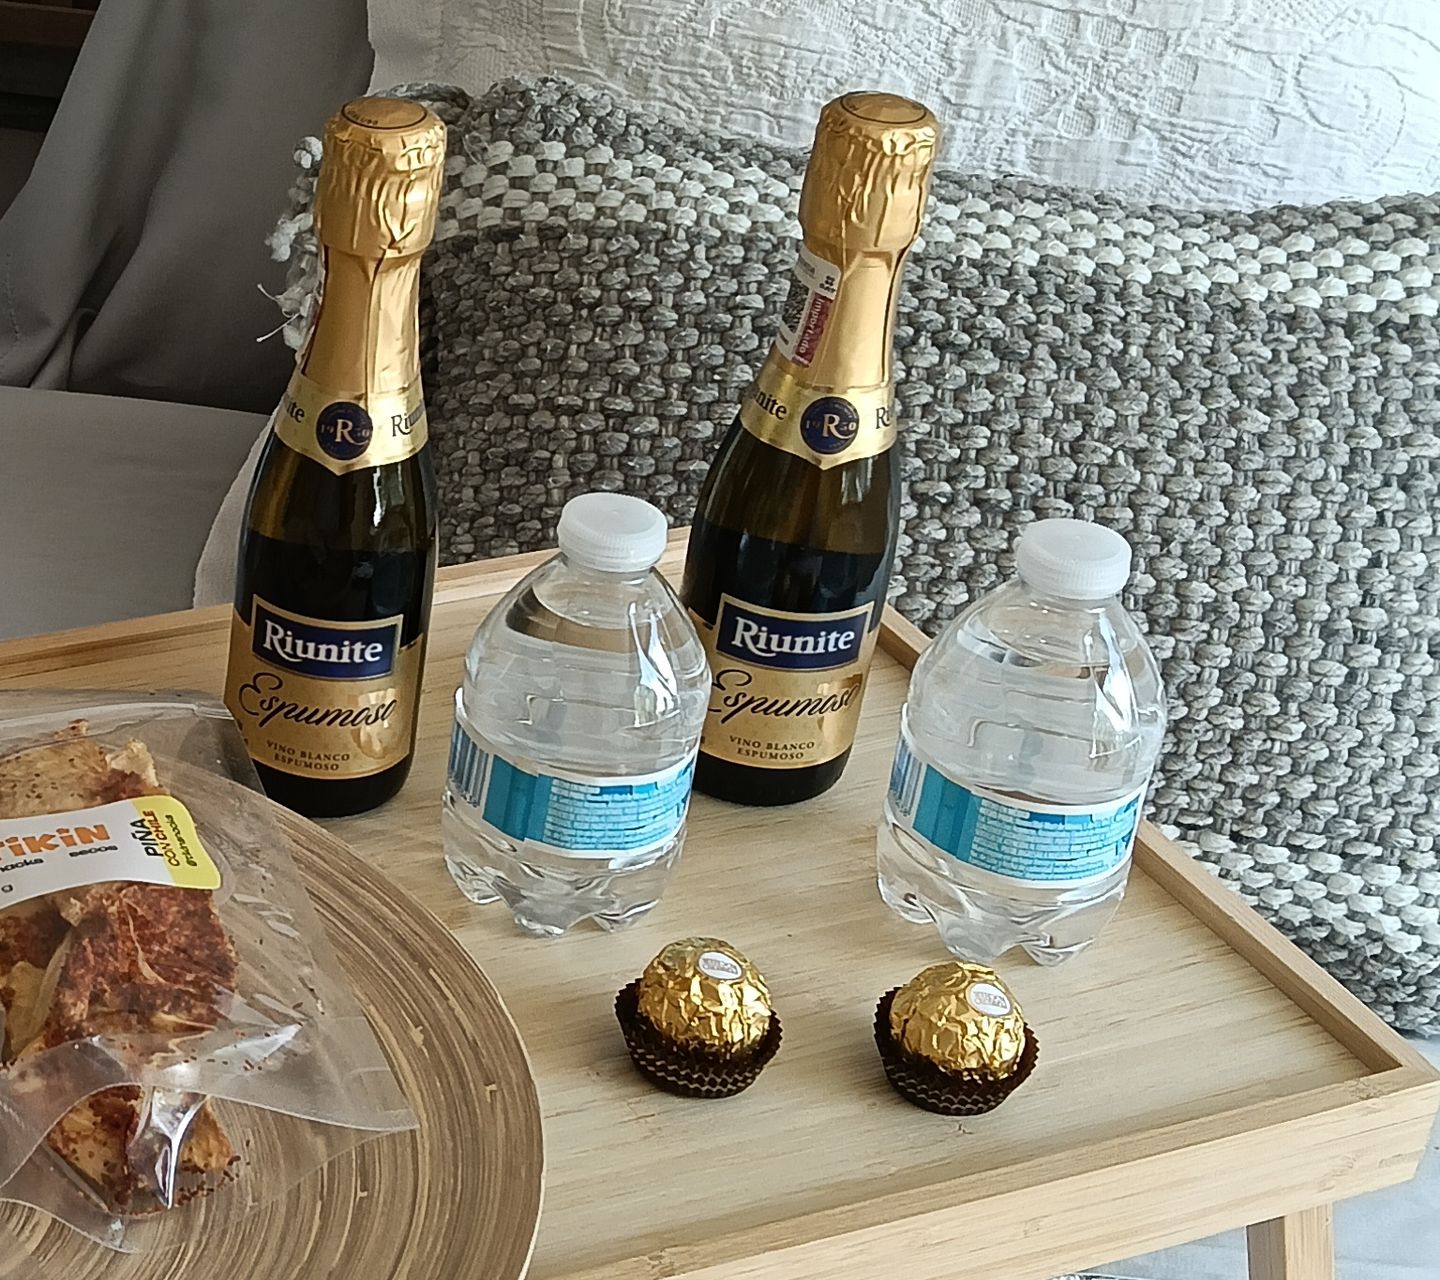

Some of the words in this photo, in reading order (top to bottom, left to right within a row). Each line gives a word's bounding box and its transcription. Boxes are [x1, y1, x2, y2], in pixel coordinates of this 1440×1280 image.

[335, 419, 368, 445] R
[822, 414, 855, 439] R
[262, 619, 383, 663] Riunite
[731, 617, 855, 657] Riunite
[239, 672, 397, 728] Espumoso
[266, 740, 296, 755] VINO
[300, 751, 350, 761] BLANCO
[729, 735, 762, 749] VINO
[766, 741, 815, 751] BLANCO
[736, 748, 804, 760] ESPUMOSO
[274, 753, 339, 771] ESPUMOSO
[143, 810, 167, 840] CHILE
[130, 818, 164, 857] PIÑA
[69, 845, 118, 857] secos
[160, 842, 180, 866] CON
[1, 884, 14, 896] g
